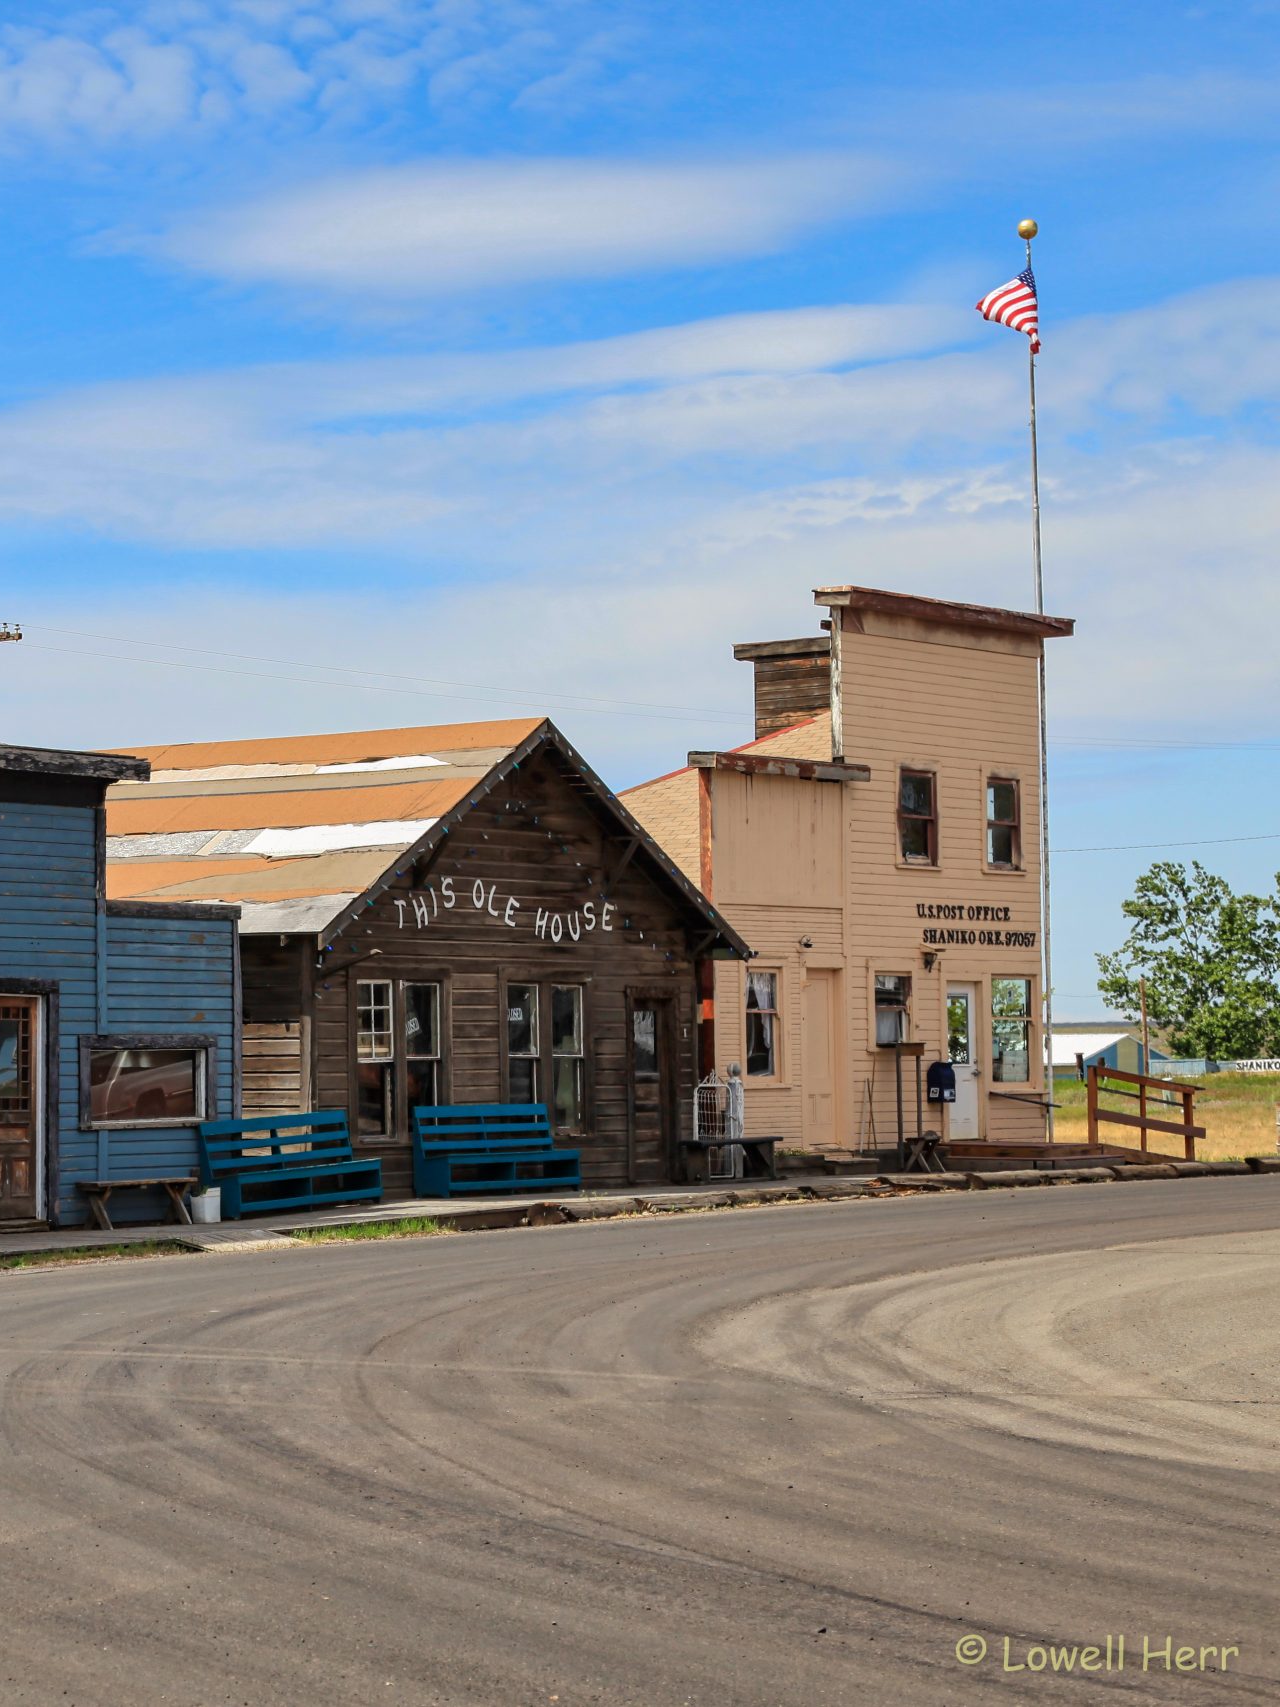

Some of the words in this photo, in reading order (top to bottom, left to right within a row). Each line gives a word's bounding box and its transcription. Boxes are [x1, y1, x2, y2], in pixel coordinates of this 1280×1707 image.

[394, 876, 456, 929] THIS
[472, 879, 521, 928] OLE
[534, 901, 617, 943] HOUSE
[967, 905, 1011, 921] OFFICE
[923, 928, 976, 945] SHANIKO
